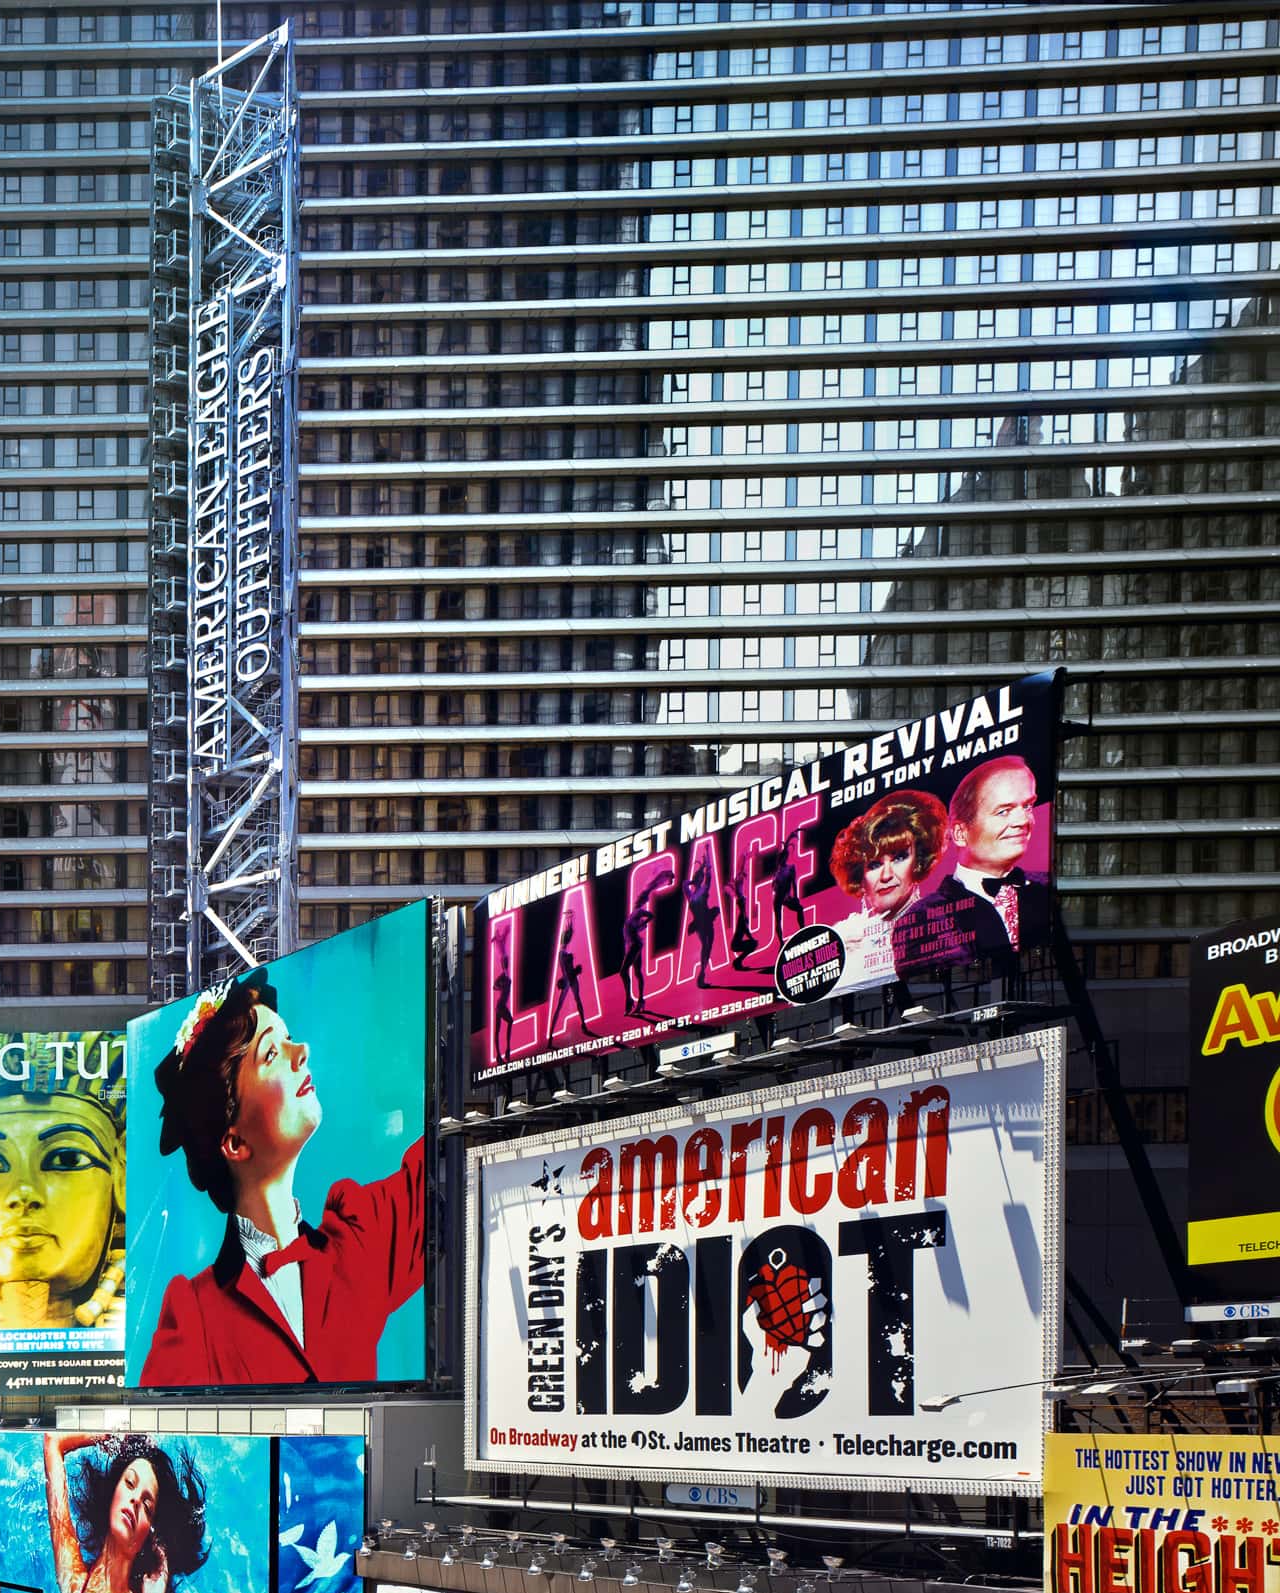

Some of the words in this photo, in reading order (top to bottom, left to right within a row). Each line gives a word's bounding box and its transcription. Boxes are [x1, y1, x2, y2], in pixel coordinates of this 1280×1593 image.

[941, 724, 1023, 769] AWARD
[487, 855, 589, 919] WINNER!
[680, 765, 830, 844] MUSICAL
[843, 685, 1024, 782] REVIVAL
[488, 883, 604, 1068] LA
[532, 1045, 575, 1067] LONGACRE
[576, 1035, 615, 1056] THEATRE
[701, 993, 774, 1022] 212.239.6200
[577, 1084, 951, 1241] american
[527, 1224, 565, 1298] DAY'S
[576, 1210, 947, 1420] IDIOT
[1240, 1303, 1271, 1318] CBS
[31, 1360, 56, 1368] TIMES
[58, 1359, 91, 1368] SQUARE
[35, 1375, 83, 1386] BETWEEN
[527, 1305, 565, 1413] GREEN
[508, 1429, 578, 1453] Broadway
[674, 1431, 731, 1454] James
[735, 1431, 810, 1455] Theatre
[833, 1432, 1017, 1463] Telecharge.com
[1105, 1449, 1169, 1471] HOTTEST
[1176, 1451, 1222, 1472] SHOW
